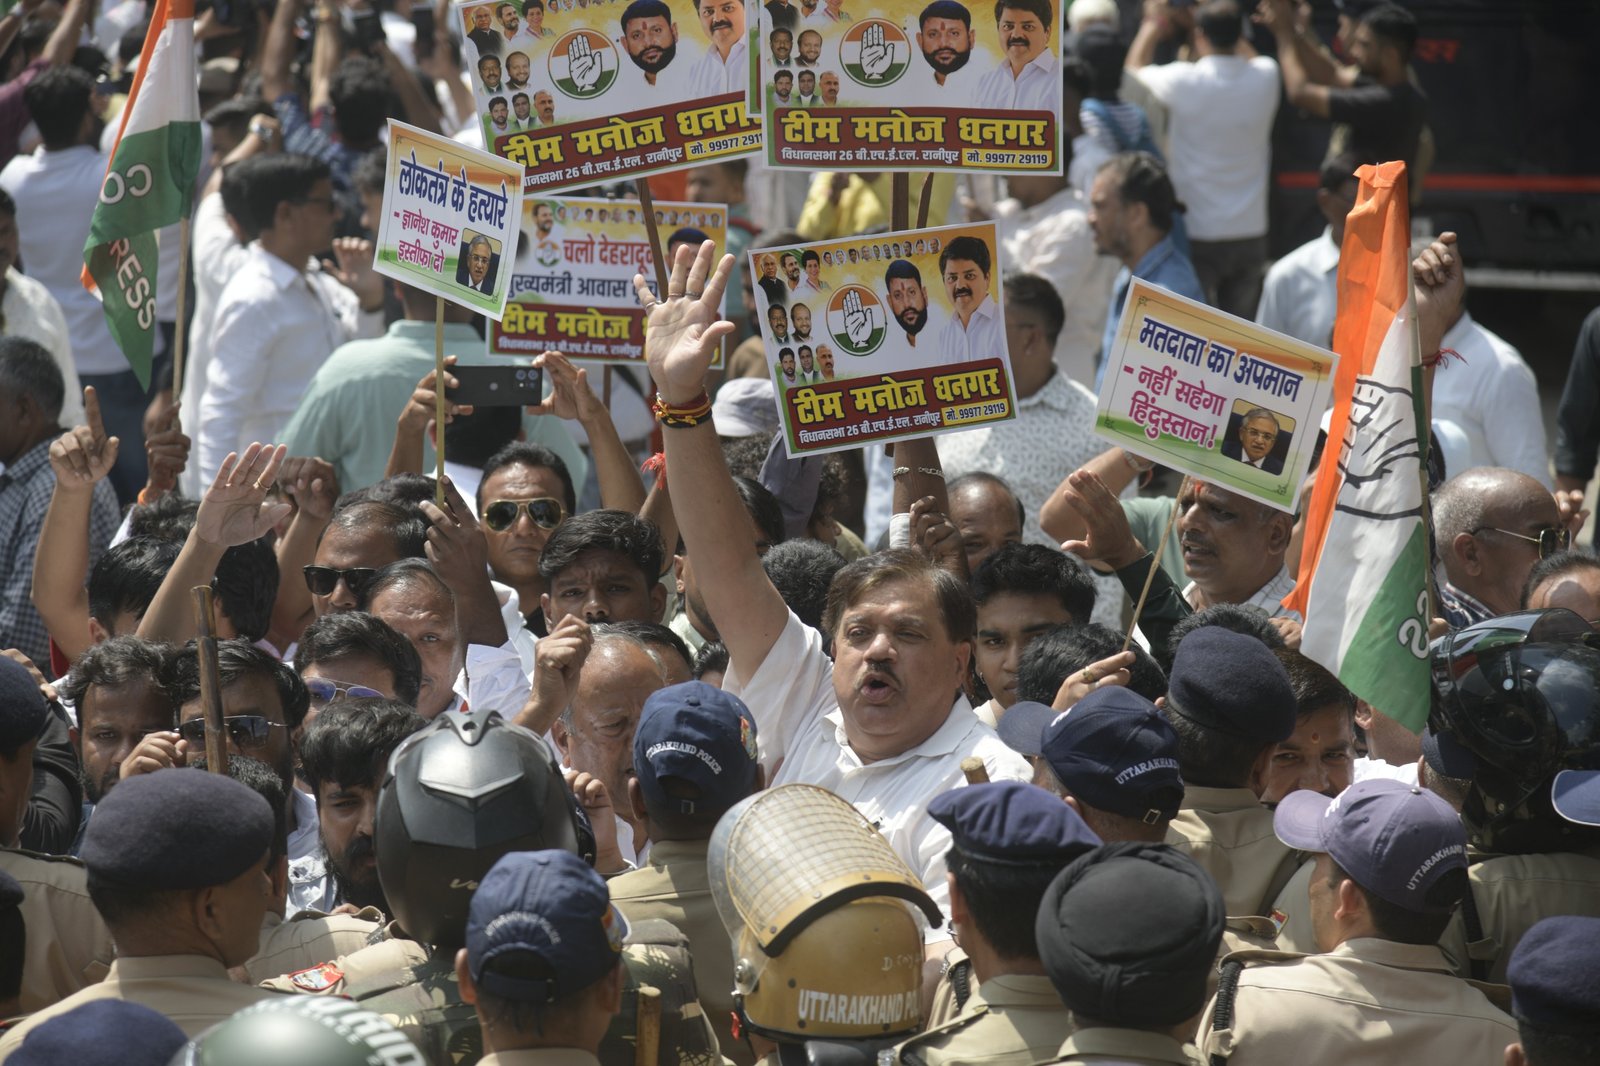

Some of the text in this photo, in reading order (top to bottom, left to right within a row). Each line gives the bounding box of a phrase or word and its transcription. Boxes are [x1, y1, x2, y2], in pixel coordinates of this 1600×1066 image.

[503, 101, 762, 168] टीम मनोज धनग
[780, 109, 1049, 146] टीम मनोज धनगर
[565, 167, 580, 179] 26
[647, 146, 683, 166] रानीपुर
[690, 142, 706, 156] मो.
[709, 137, 740, 153] 99977
[781, 148, 1048, 165] विधानसभा 26 बी.एच.ई.एल. रानीपुर मो. 99977 29119
[400, 151, 506, 228] लोकतंत्र के हत्यारे
[402, 208, 430, 235] ज्ञानेश
[431, 220, 459, 249] कुमार
[398, 238, 445, 273] इस्तीफा दो
[563, 233, 594, 265] चलो
[577, 277, 627, 298] आवास
[501, 303, 547, 335] टीम
[555, 308, 632, 340] मनोज
[1139, 317, 1303, 401] मतदाता का अपमान
[793, 368, 1001, 424] टीम मनोज धनगर
[1138, 365, 1178, 396] नहीं
[1175, 380, 1227, 417] सहेगा
[799, 402, 1006, 443] विधानसभा 26 बी.एच.ई.एल. रानीपुर मो. 99977 29119
[696, 749, 722, 775] POLICE
[798, 988, 903, 1025] UTTARAKHAND
